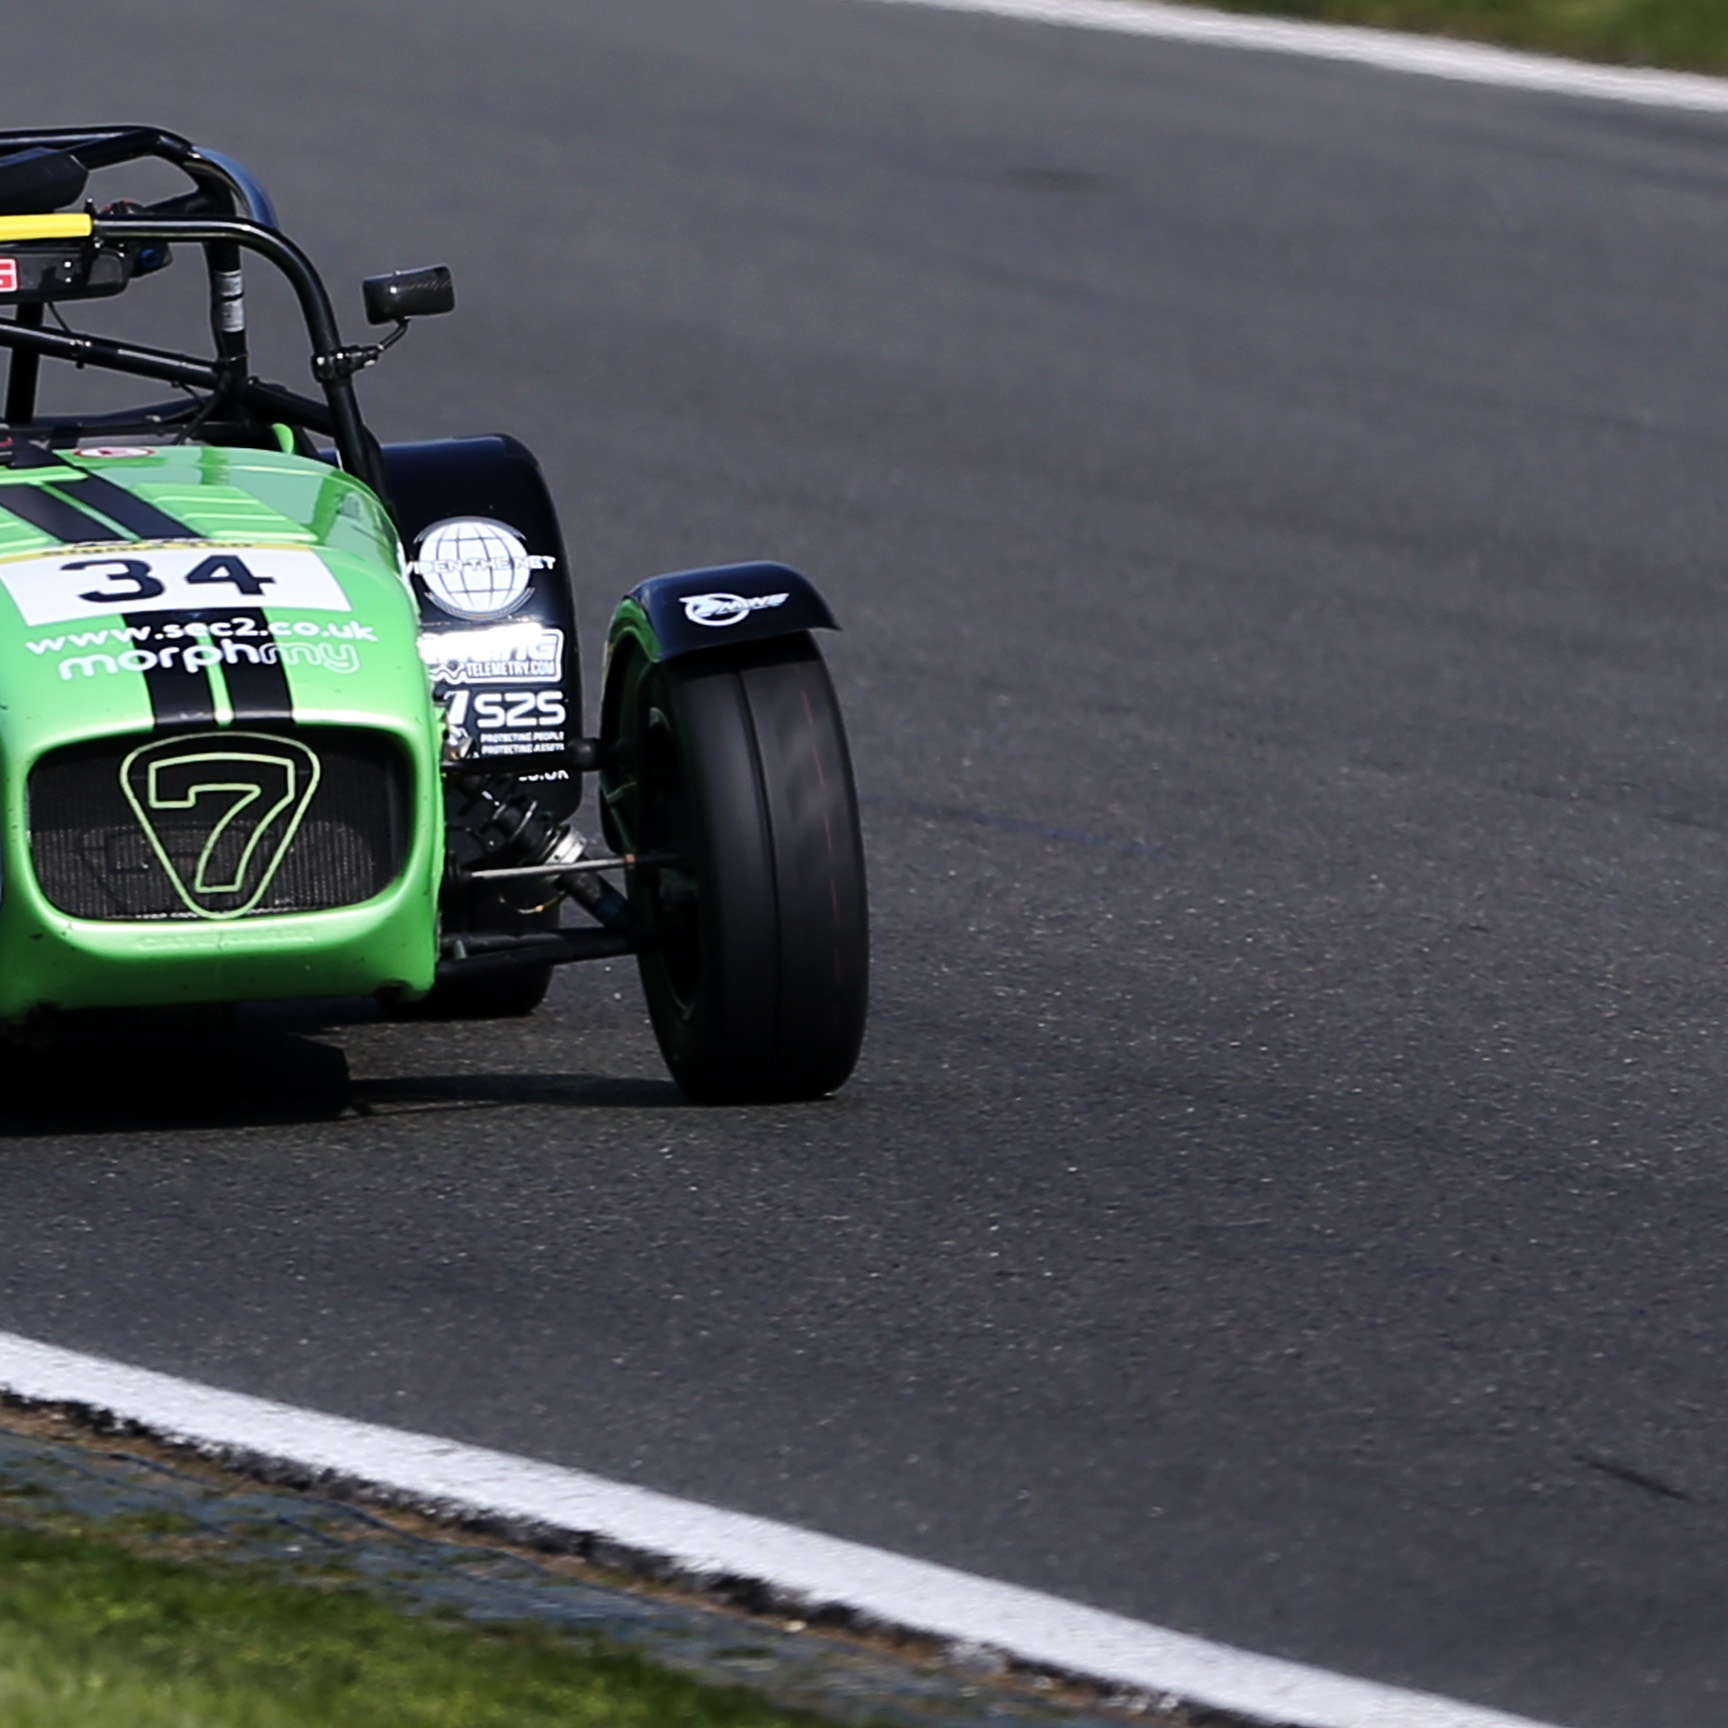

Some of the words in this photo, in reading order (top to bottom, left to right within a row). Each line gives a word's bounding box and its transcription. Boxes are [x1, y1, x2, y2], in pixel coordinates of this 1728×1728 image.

[59, 554, 277, 604] 34
[25, 617, 379, 655] www.sec2.co.uk
[465, 660, 555, 677] TELEMETRY.COM
[473, 690, 567, 729] S2S
[148, 751, 295, 893] 7
